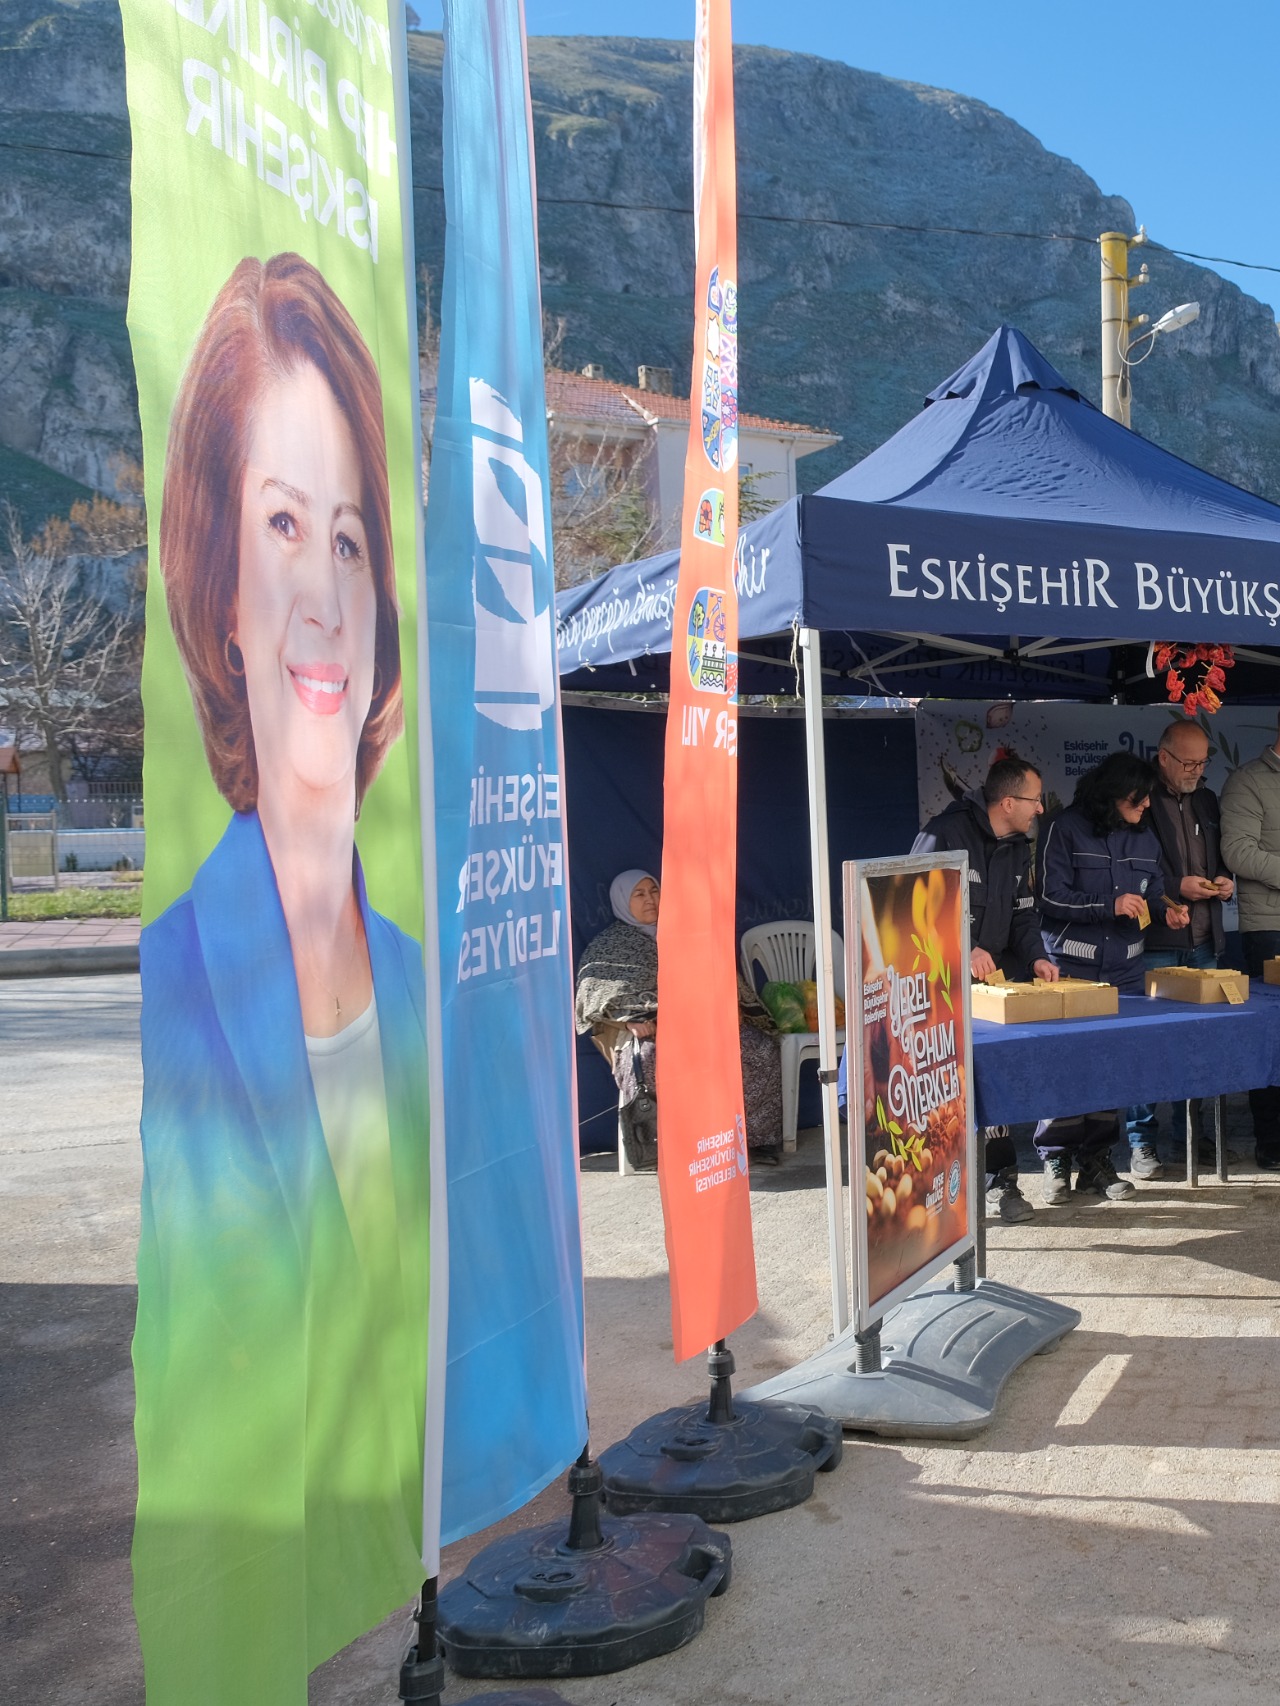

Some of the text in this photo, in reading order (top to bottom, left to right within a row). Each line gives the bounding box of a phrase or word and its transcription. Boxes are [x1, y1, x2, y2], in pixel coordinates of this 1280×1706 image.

[886, 543, 1119, 613] ESKİŞEHİR
[1063, 740, 1109, 752] Eskişehir
[886, 964, 931, 1038] YEREL
[901, 1012, 956, 1075] TOHUM
